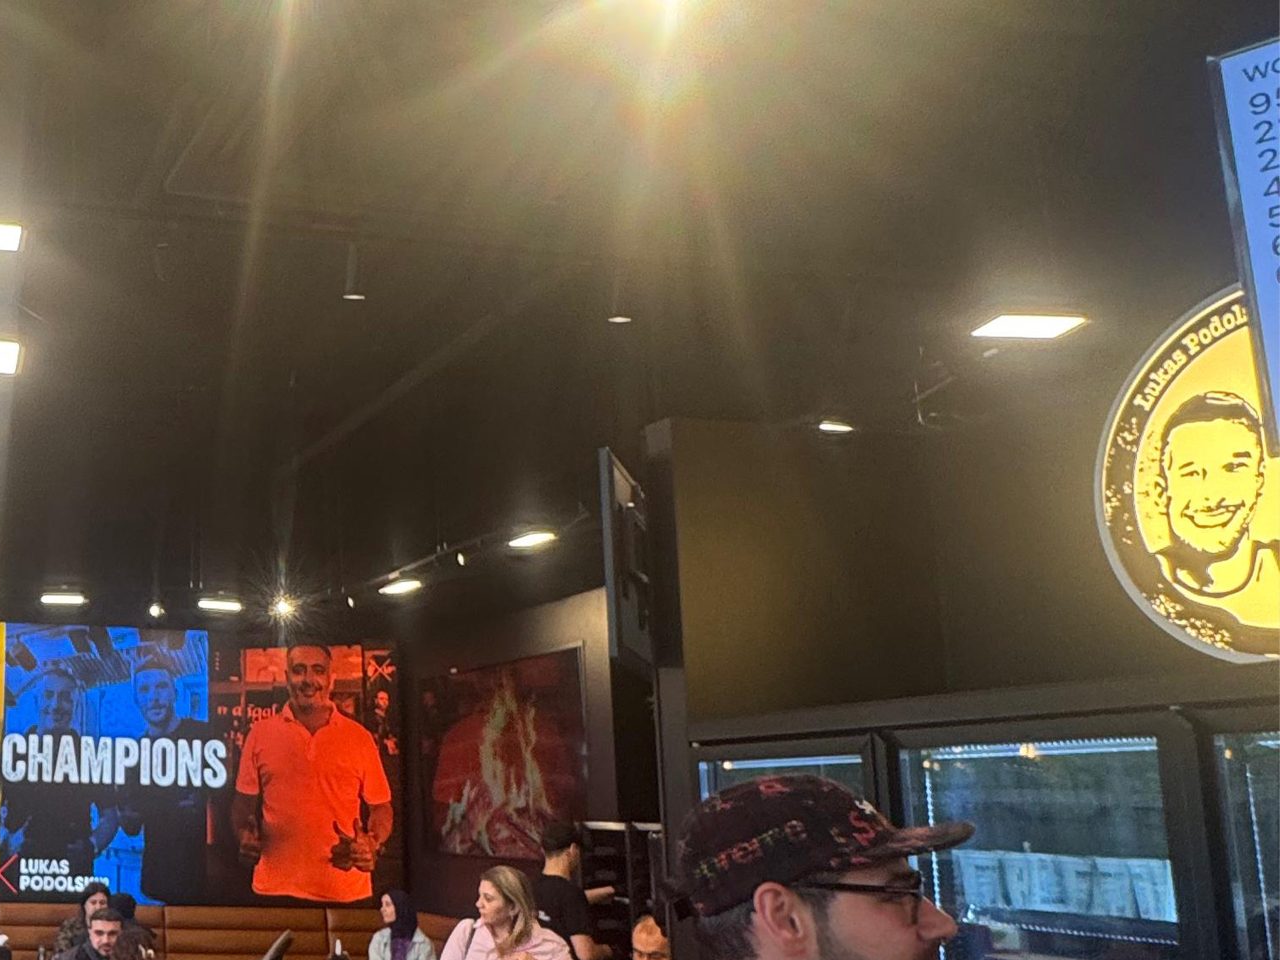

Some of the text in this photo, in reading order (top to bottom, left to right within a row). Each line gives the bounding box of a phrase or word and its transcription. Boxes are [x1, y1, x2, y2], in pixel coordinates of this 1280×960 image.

[1248, 87, 1280, 115] 9
[1133, 349, 1187, 411] Lukas
[1, 732, 227, 788] CHAMPIONS
[20, 858, 70, 875] LUKAS
